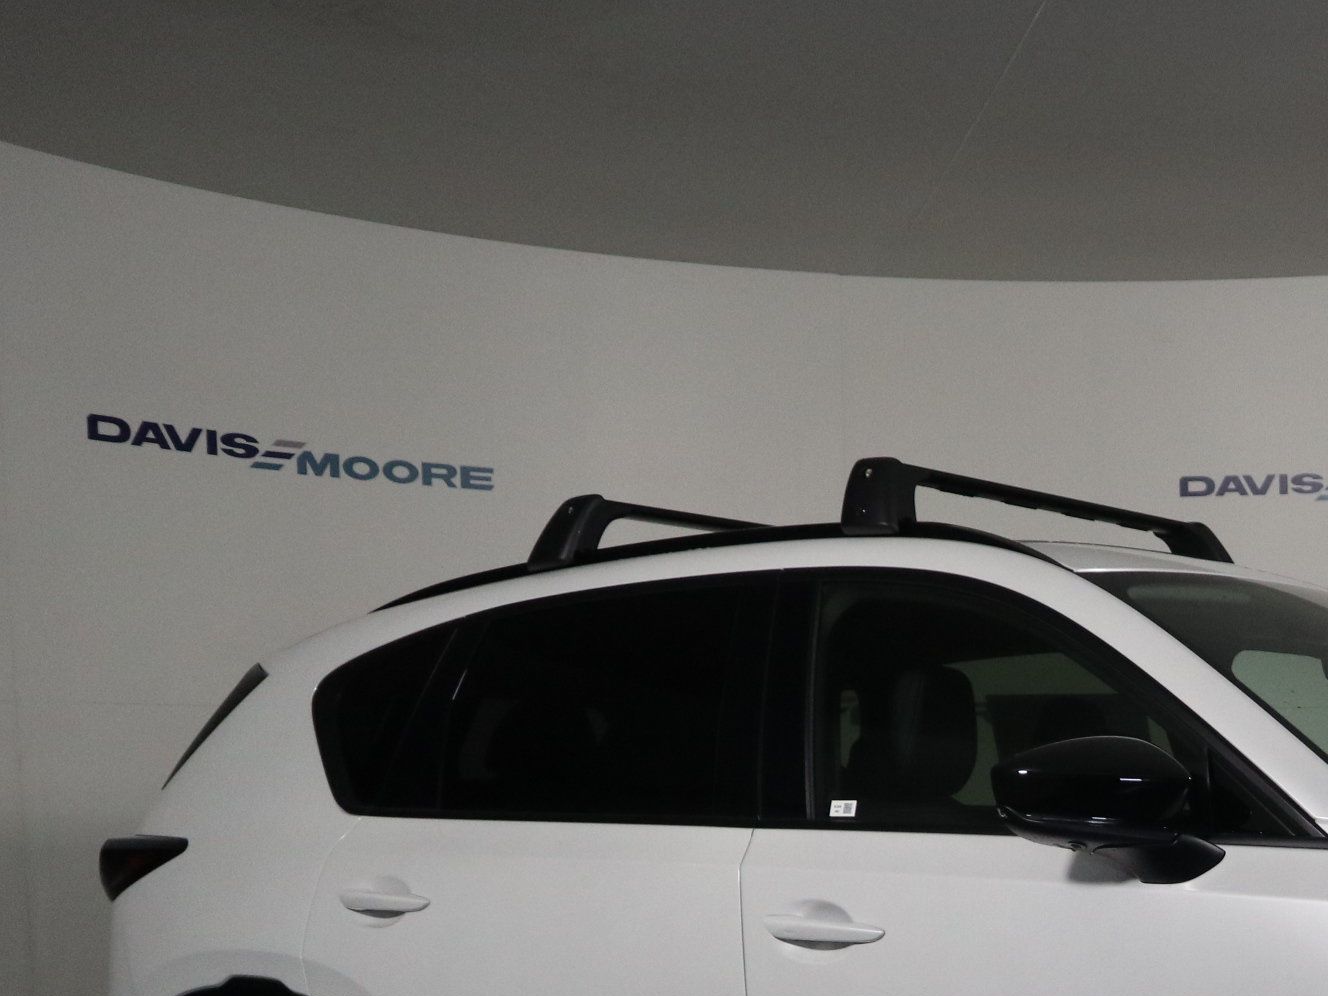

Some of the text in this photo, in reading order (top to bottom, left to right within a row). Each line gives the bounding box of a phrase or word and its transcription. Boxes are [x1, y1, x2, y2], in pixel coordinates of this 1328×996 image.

[86, 412, 495, 491] DAVIS MOORE
[1178, 472, 1324, 498] DAVIS
